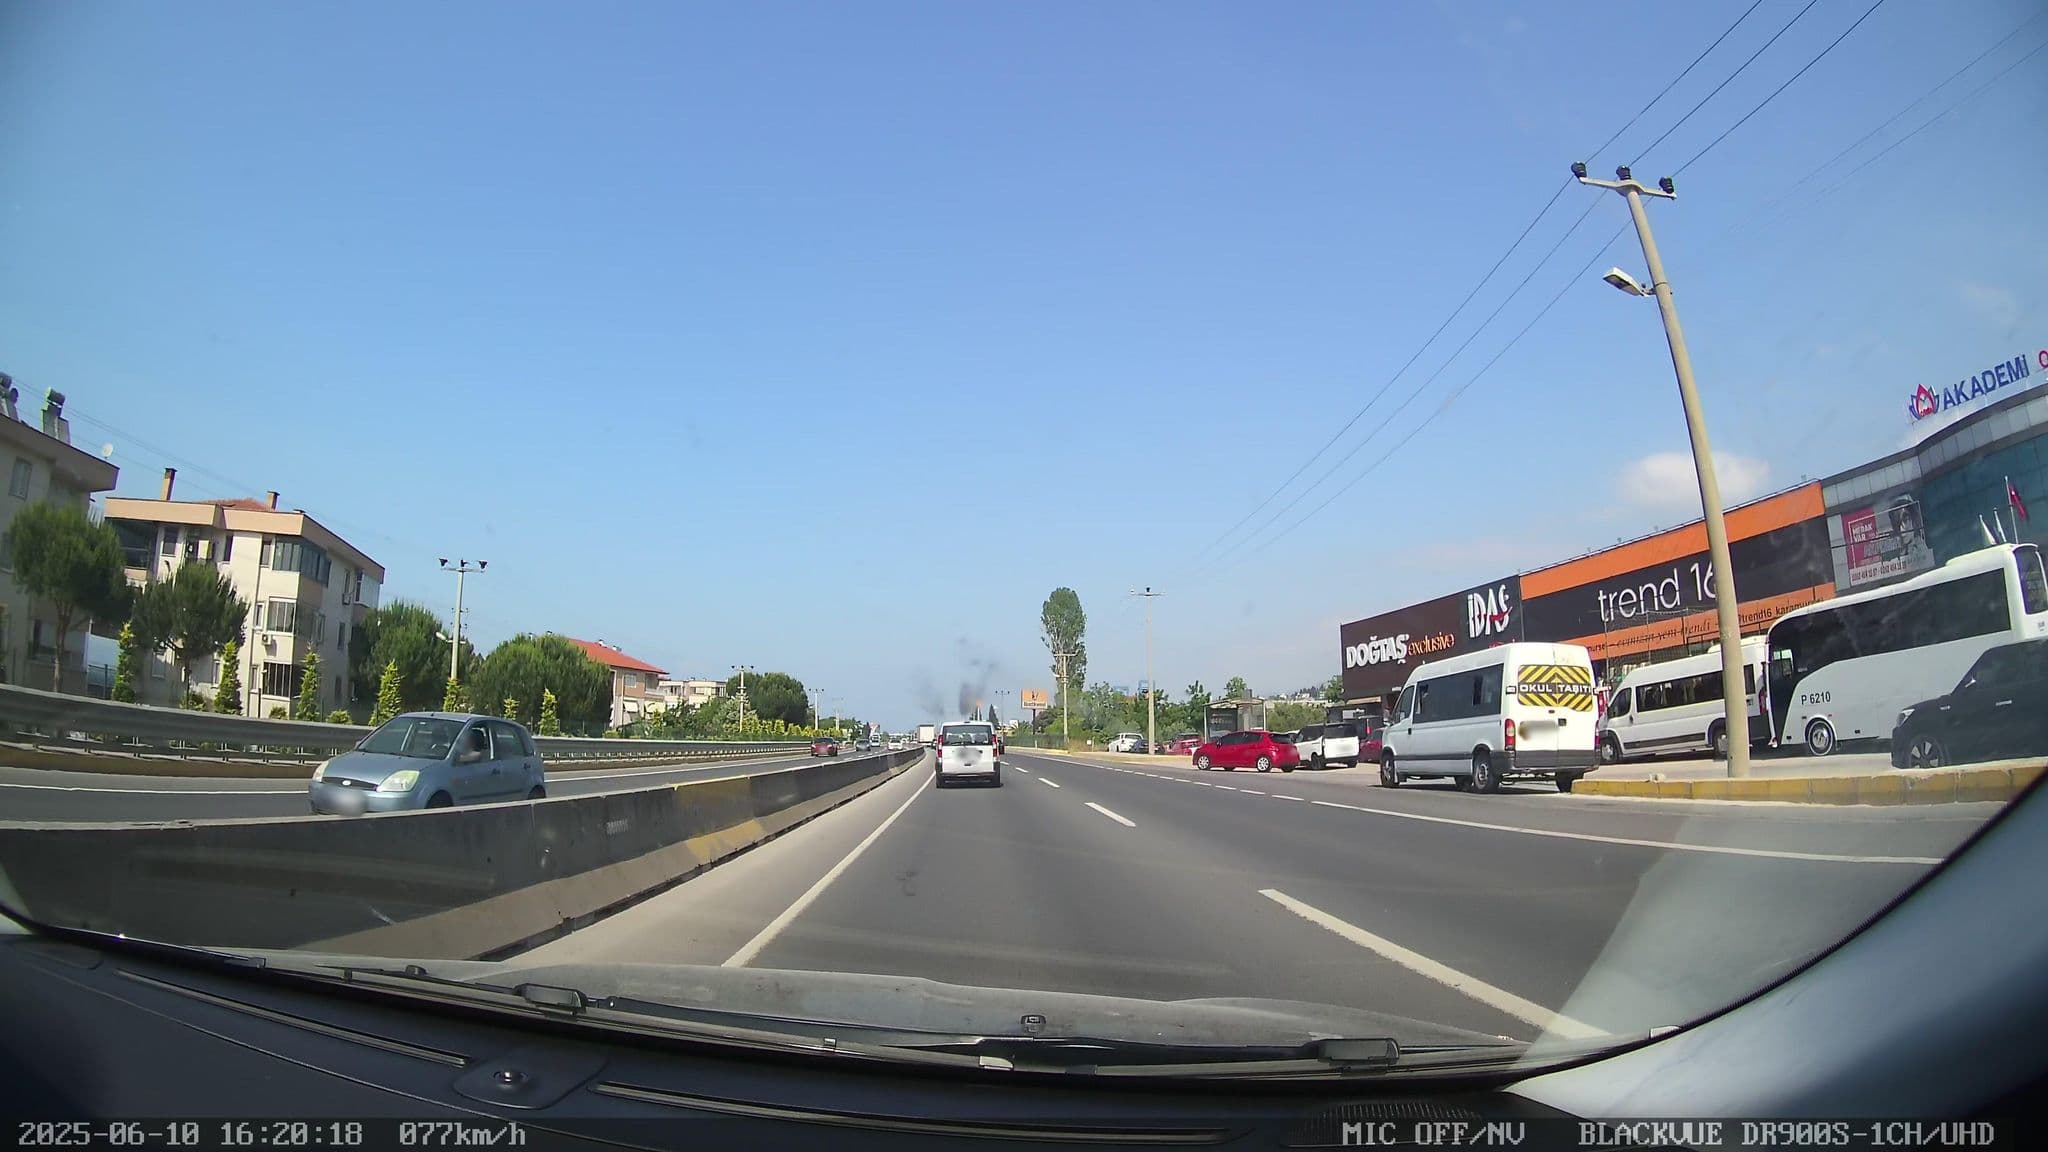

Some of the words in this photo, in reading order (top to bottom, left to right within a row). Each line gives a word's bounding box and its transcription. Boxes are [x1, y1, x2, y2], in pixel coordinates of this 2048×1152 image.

[1943, 354, 2030, 411] AKADEMİ
[1597, 567, 1681, 622] trend
[1346, 634, 1409, 669] DOĞTAŞ
[1407, 631, 1455, 657] exclusive
[1520, 684, 1553, 693] OKUL
[1801, 694, 1807, 705] P
[1810, 691, 1831, 704] 6210
